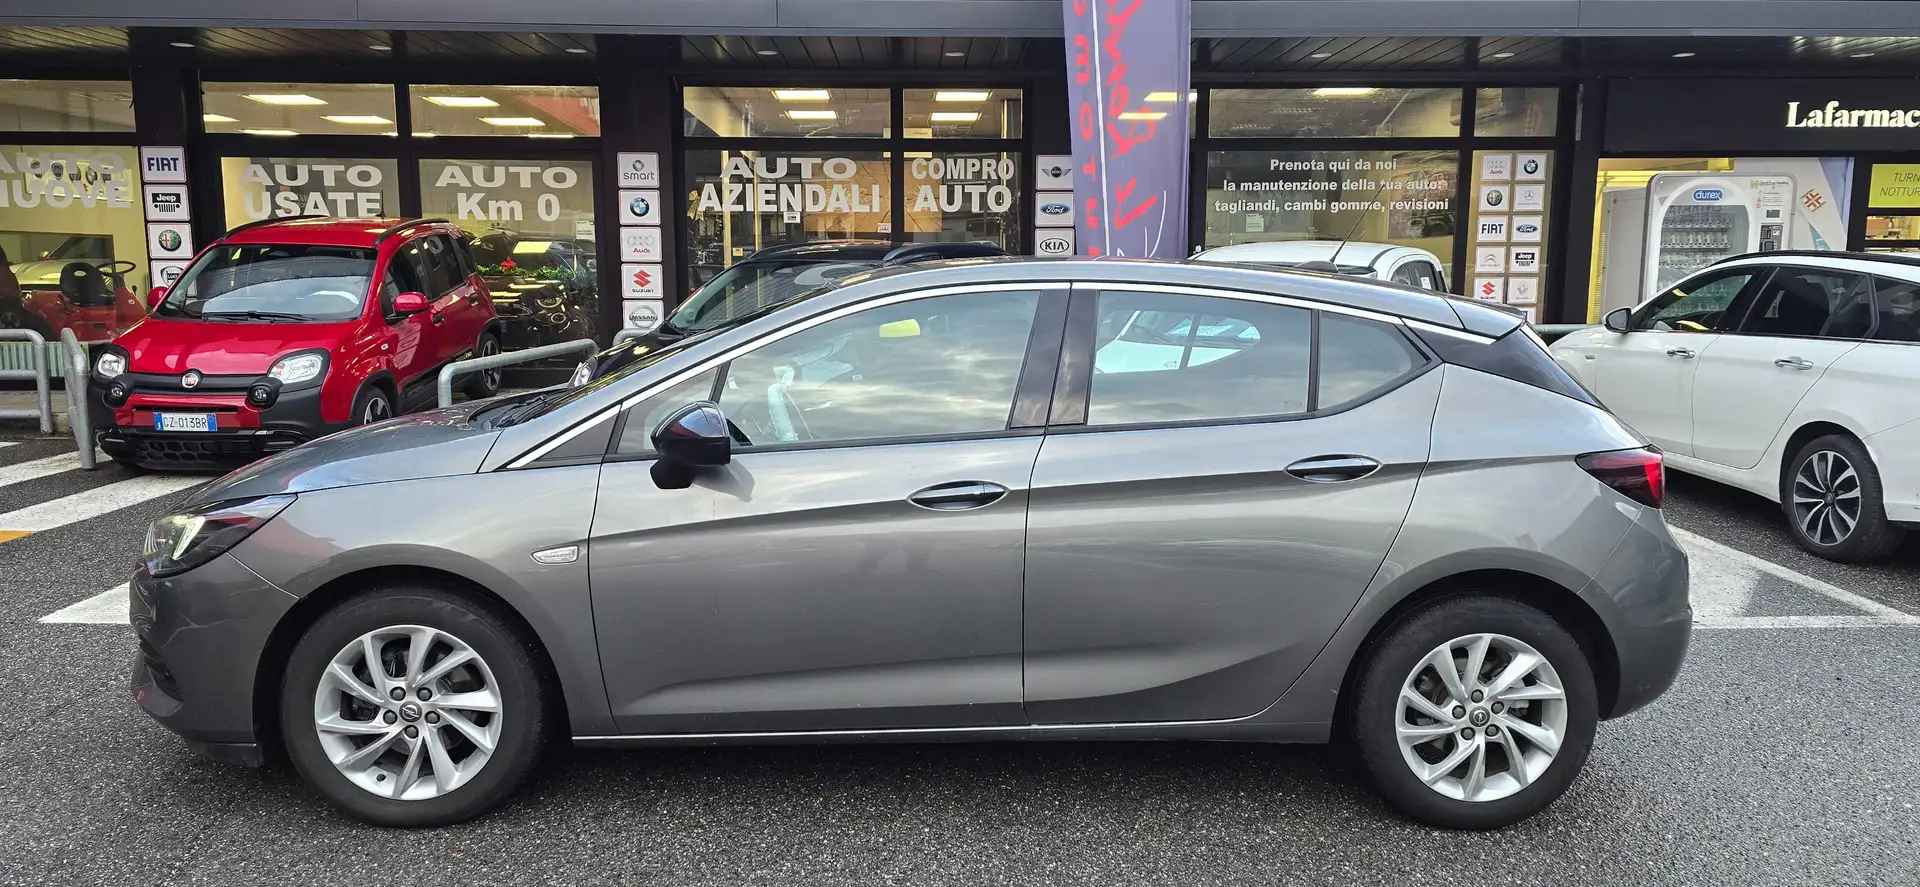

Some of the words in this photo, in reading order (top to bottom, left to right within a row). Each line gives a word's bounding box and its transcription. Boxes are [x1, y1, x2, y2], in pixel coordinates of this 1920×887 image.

[147, 157, 179, 172] FIAT
[720, 157, 857, 179] AUTO
[911, 157, 1015, 180] COMPRO
[1270, 159, 1325, 171] Prenota
[1329, 158, 1350, 173] qui
[1354, 159, 1371, 171] da
[1375, 159, 1397, 171] noi
[239, 164, 383, 188] AUTO
[434, 165, 578, 189] AUTO
[623, 171, 655, 181] smart
[1223, 179, 1236, 191] la
[1240, 179, 1338, 191] manutenzione
[1341, 178, 1376, 191] della
[1380, 179, 1403, 191] tua
[0, 179, 133, 208] UOVE
[156, 193, 177, 203] Jeep
[697, 183, 881, 213] AZIENDALI
[913, 184, 1012, 213] AUTO
[1695, 190, 1721, 200] durex
[244, 191, 381, 220] USATE
[457, 192, 523, 221] Km
[537, 193, 561, 222] 0
[1045, 204, 1065, 213] Ford
[1214, 199, 1280, 214] tagliandi,
[1284, 199, 1327, 211] cambi
[1330, 201, 1386, 213] gomme,
[1389, 198, 1449, 211] revisioni
[1481, 223, 1504, 234] FIAT
[1045, 241, 1065, 250] KIA
[1517, 251, 1533, 260] Jeep
